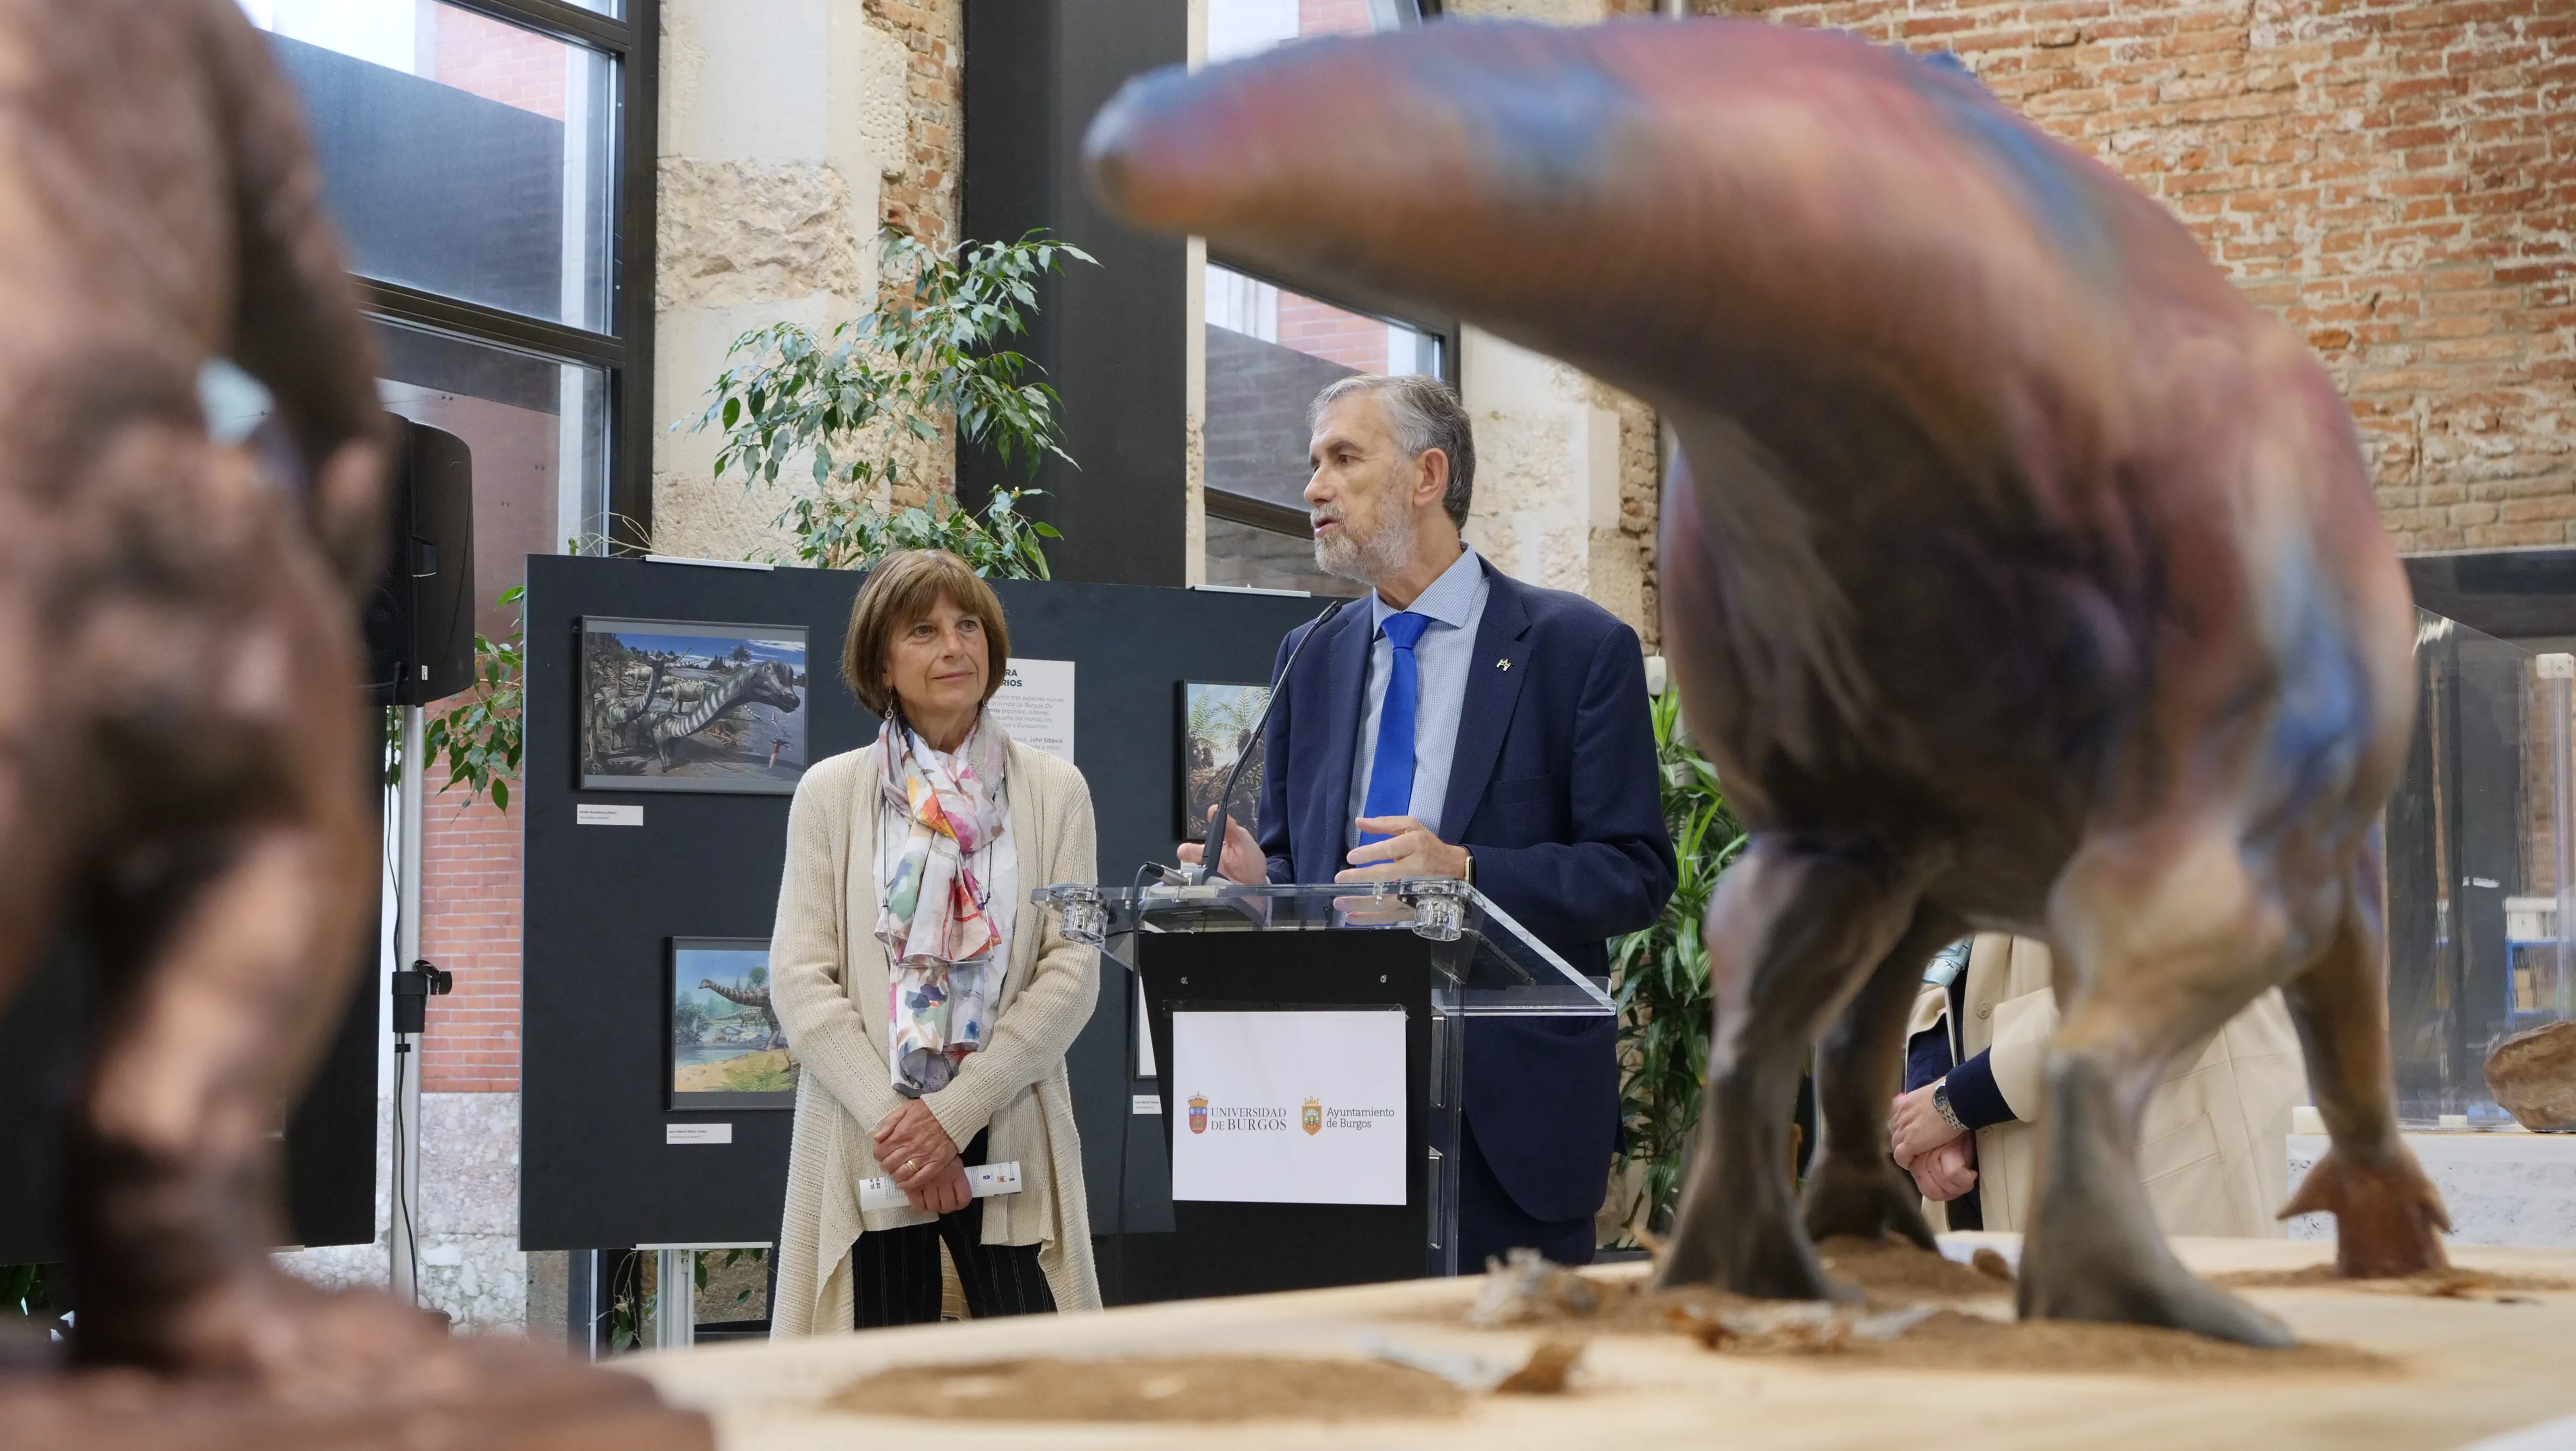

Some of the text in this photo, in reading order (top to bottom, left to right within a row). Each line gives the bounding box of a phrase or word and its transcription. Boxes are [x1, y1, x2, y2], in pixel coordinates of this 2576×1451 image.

[1211, 1107, 1286, 1117] UNIVERSIDAD
[1326, 1107, 1394, 1119] Ayuntamiento
[1210, 1119, 1287, 1130] DE BURGOS
[1326, 1118, 1371, 1130] de Burgos
